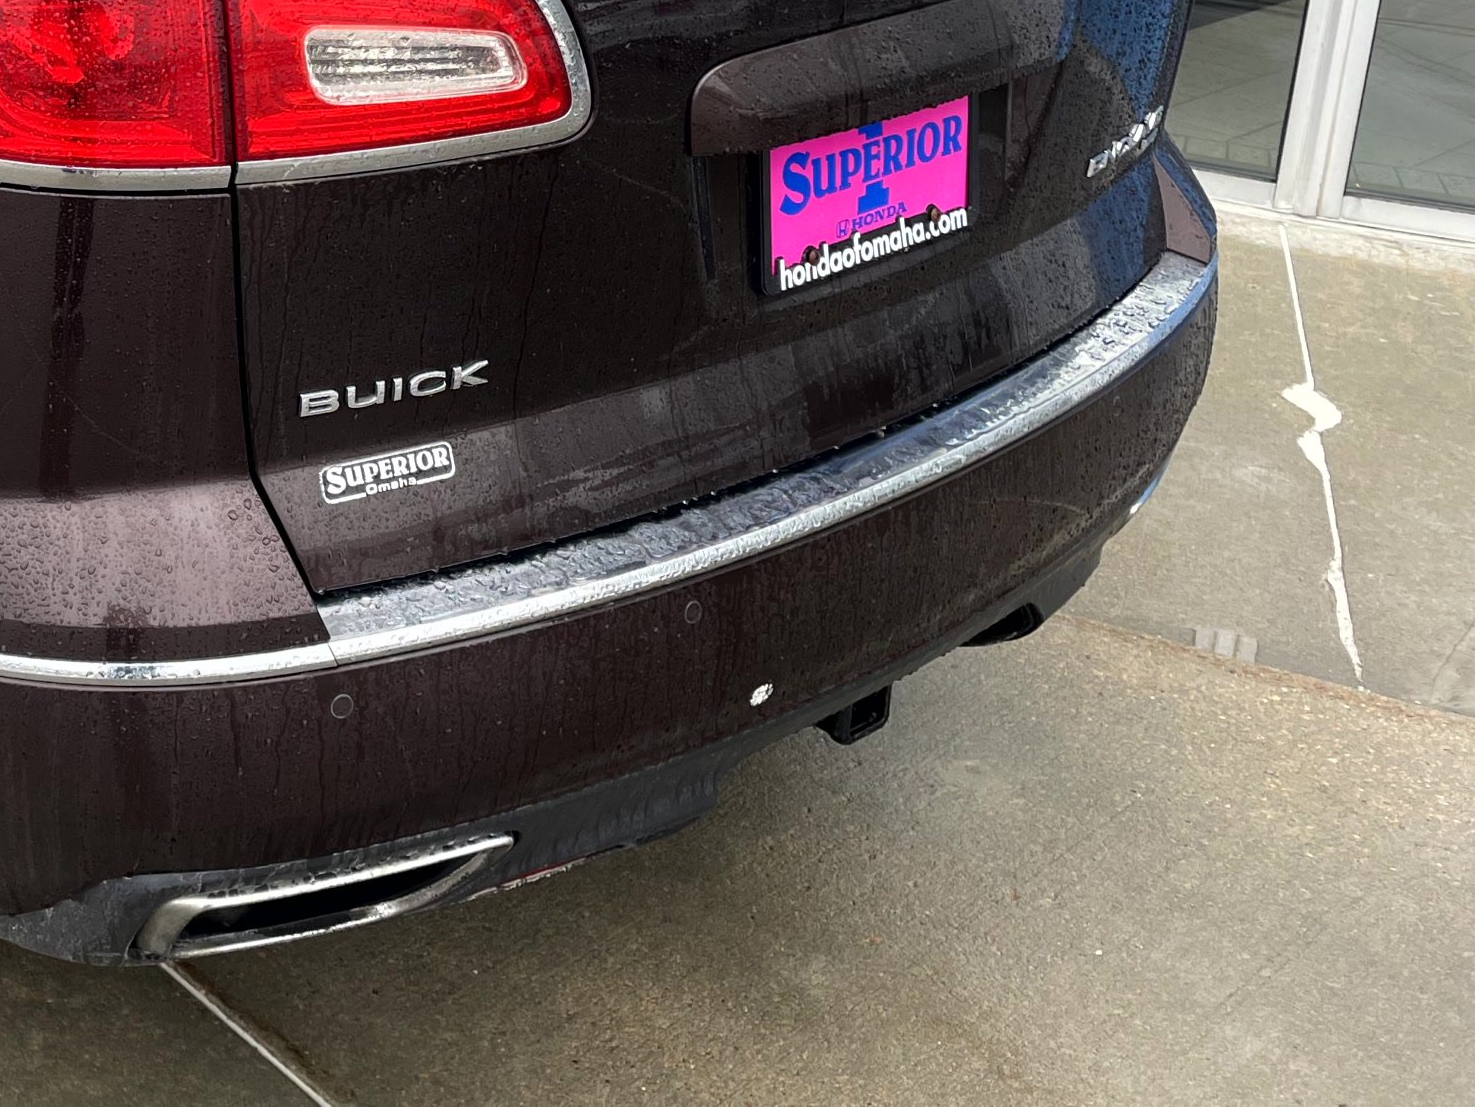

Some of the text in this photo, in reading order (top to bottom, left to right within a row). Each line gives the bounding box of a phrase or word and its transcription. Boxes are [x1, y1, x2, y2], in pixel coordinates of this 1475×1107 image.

[779, 114, 963, 216] SUPERIOR
[851, 201, 908, 232] HONDA
[779, 206, 968, 293] hondaofomaha.com
[299, 359, 490, 418] BUICK
[325, 446, 451, 495] SUPERIOR
[365, 477, 418, 495] Omaha
